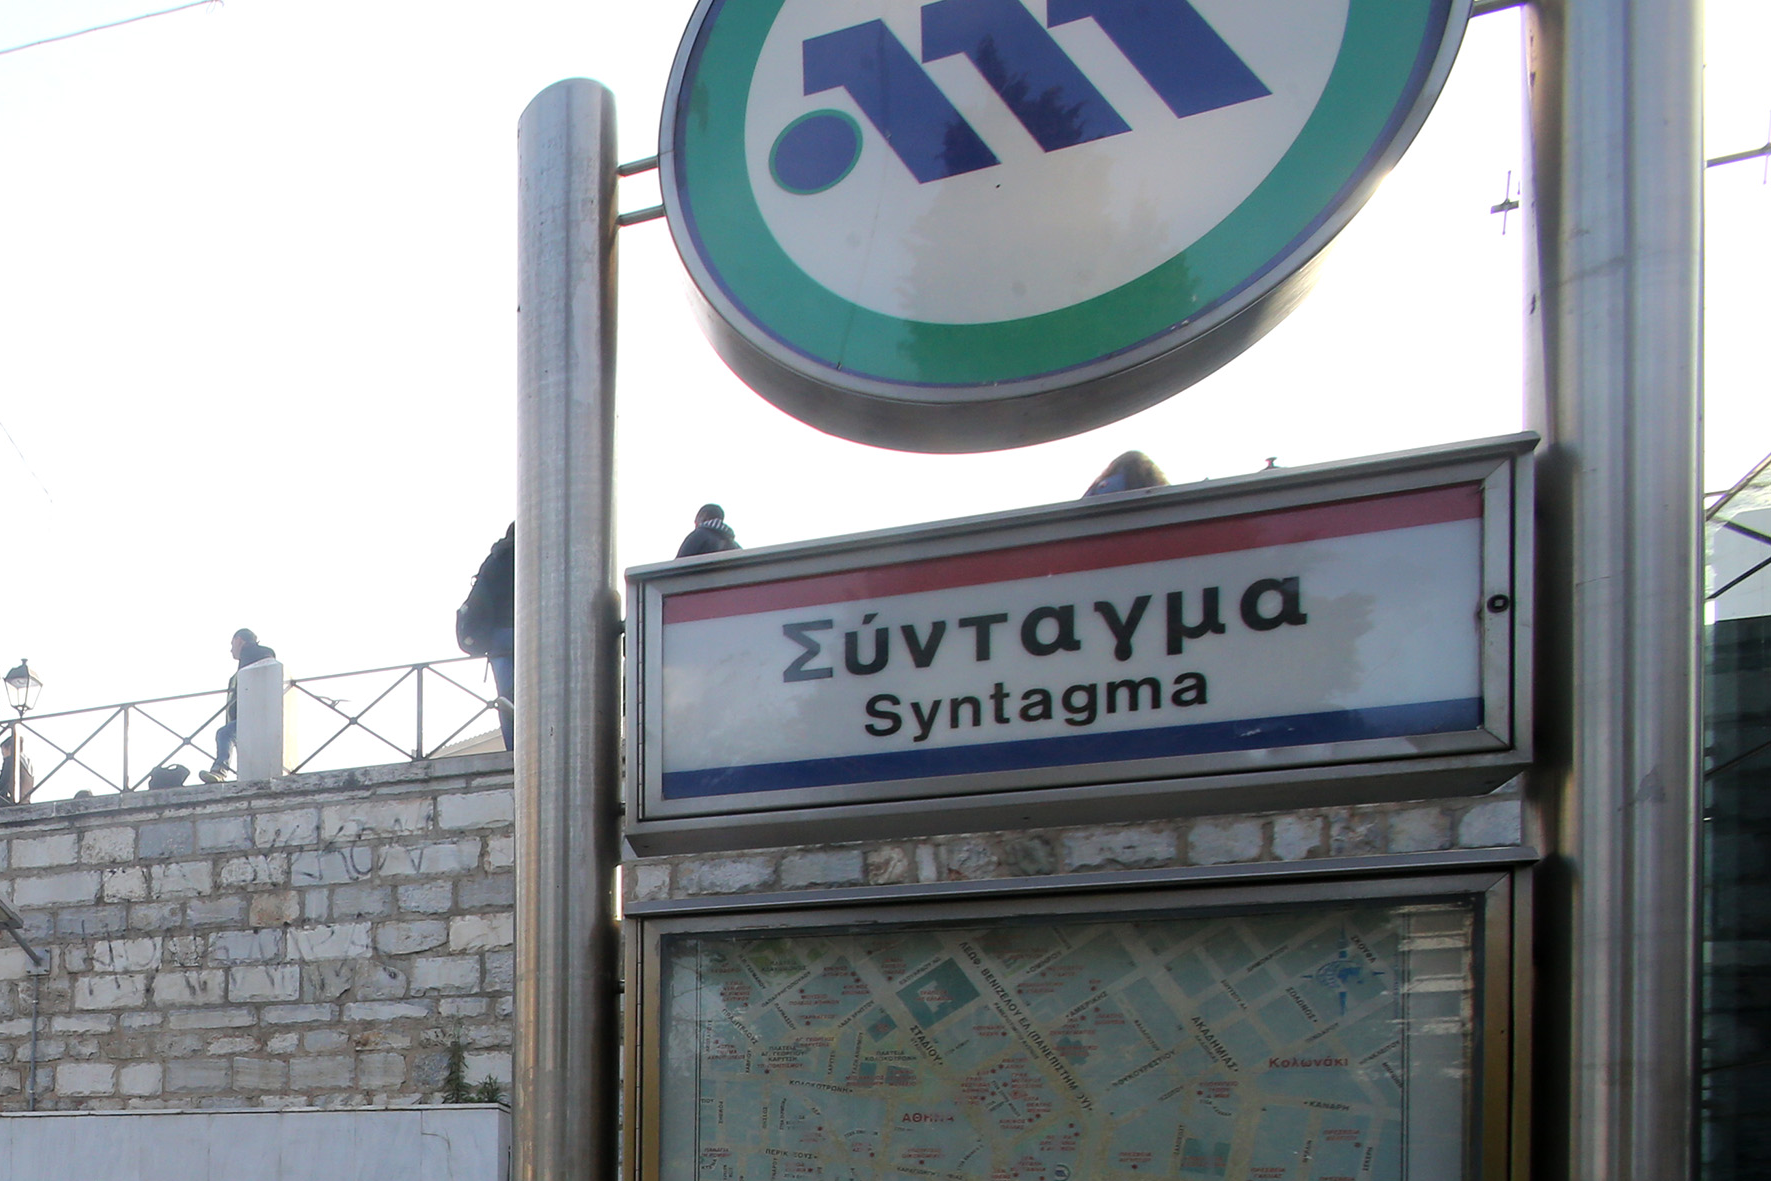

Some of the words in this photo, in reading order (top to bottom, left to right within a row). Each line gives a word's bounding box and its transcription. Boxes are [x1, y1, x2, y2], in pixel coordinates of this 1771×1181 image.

[783, 576, 1307, 683] Σύνταγμα
[864, 671, 1208, 742] Syntagma
[981, 968, 1022, 1017] ΒΕΝΙΖΕΛΟΥ
[910, 1024, 942, 1062] ΣΤΑΔΙΟΥ
[1191, 1016, 1238, 1069] ΑΚΑΔΗΜΙΑΣ
[1269, 1056, 1348, 1068] Κολωνάκι
